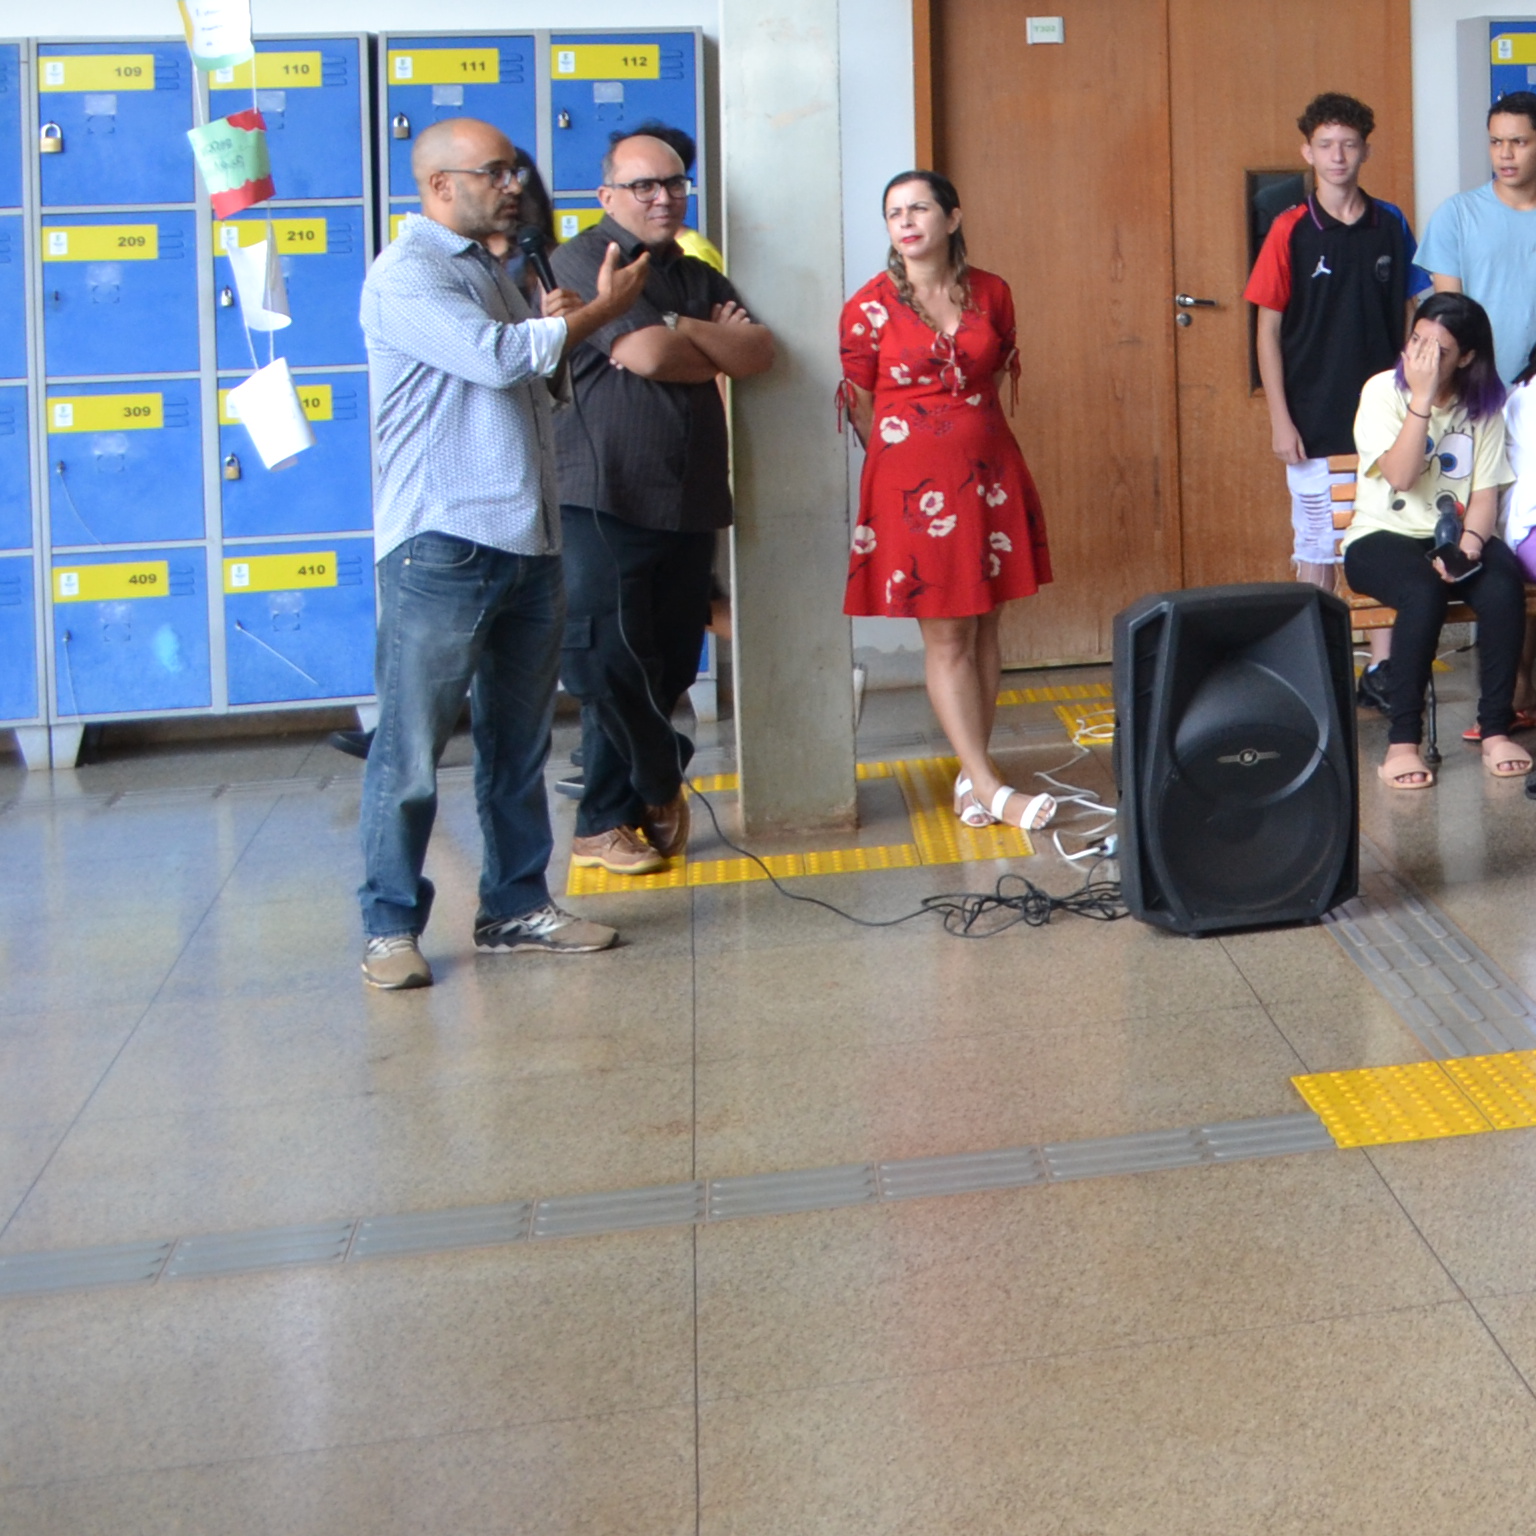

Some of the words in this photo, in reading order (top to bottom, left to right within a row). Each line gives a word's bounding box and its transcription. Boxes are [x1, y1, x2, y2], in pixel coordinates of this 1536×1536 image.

[459, 60, 486, 72] 111
[621, 56, 648, 67] 112
[115, 66, 143, 77] 109
[282, 63, 311, 75] 110
[117, 235, 146, 248] 209
[286, 230, 315, 242] 210
[302, 397, 321, 409] 10
[123, 405, 152, 418] 309
[296, 564, 326, 576] 410
[128, 573, 158, 585] 409
